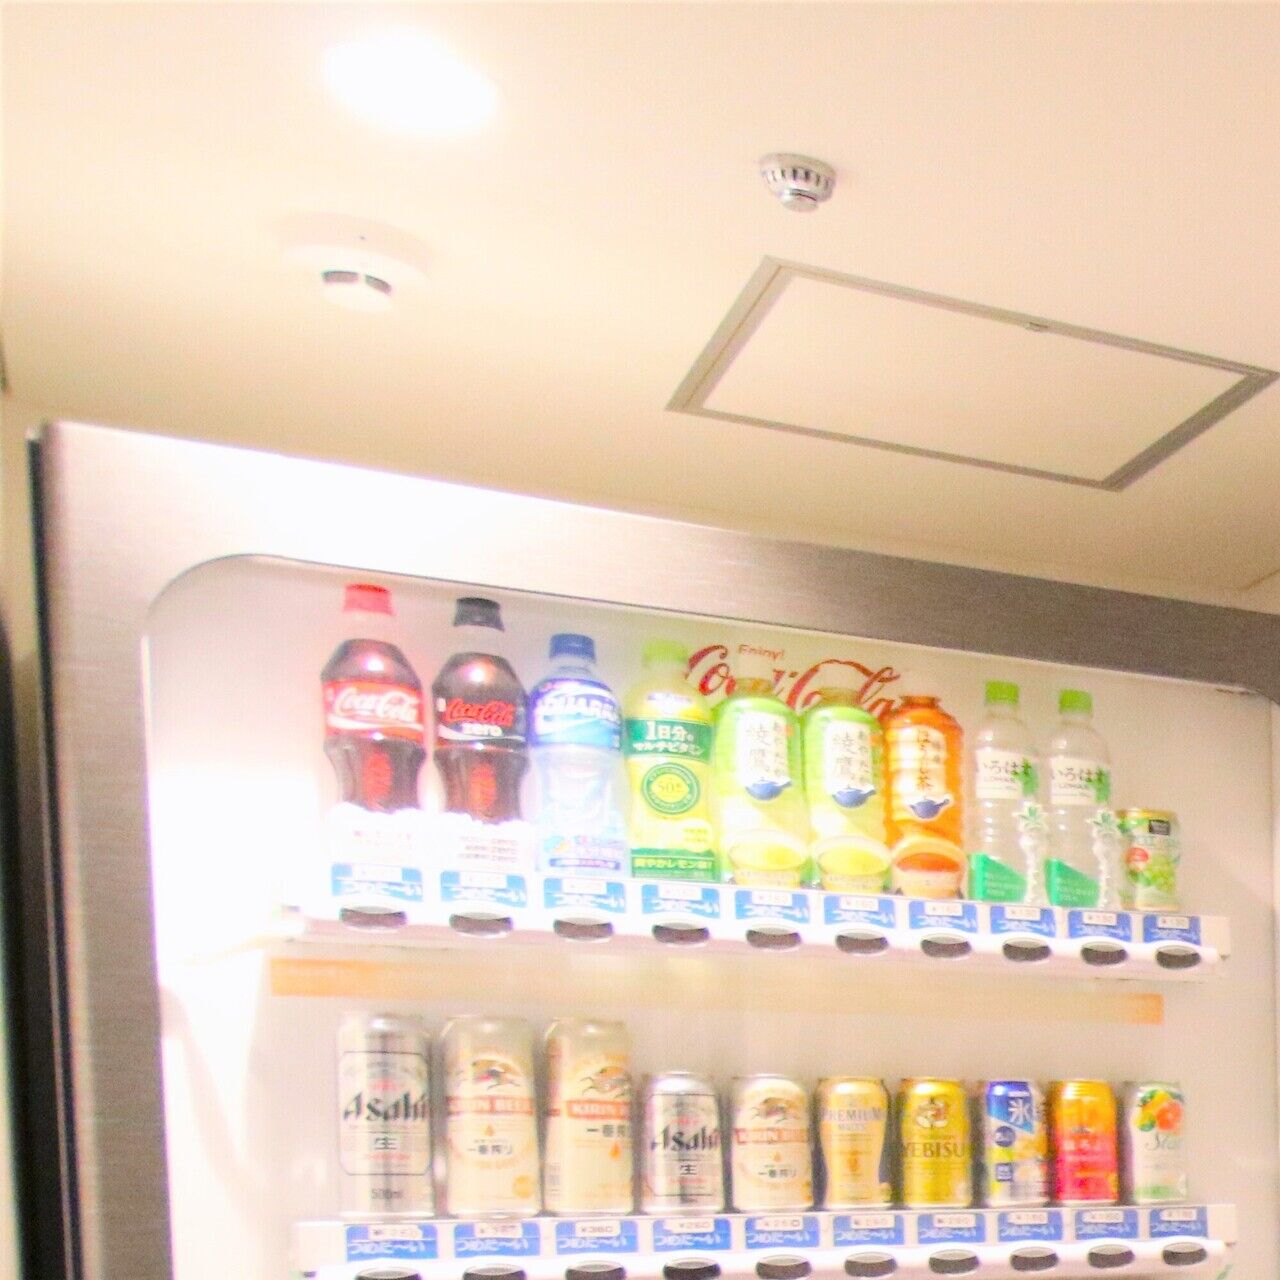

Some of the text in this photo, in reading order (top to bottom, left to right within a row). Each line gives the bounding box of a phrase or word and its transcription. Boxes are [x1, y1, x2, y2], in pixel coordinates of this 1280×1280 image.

[337, 686, 419, 723] Coca-Cola
[446, 697, 514, 728] Coca-Cola
[342, 1090, 427, 1122] Asahi
[372, 1136, 397, 1150] 生
[650, 1125, 722, 1151] Asahi
[679, 1162, 698, 1176] 生
